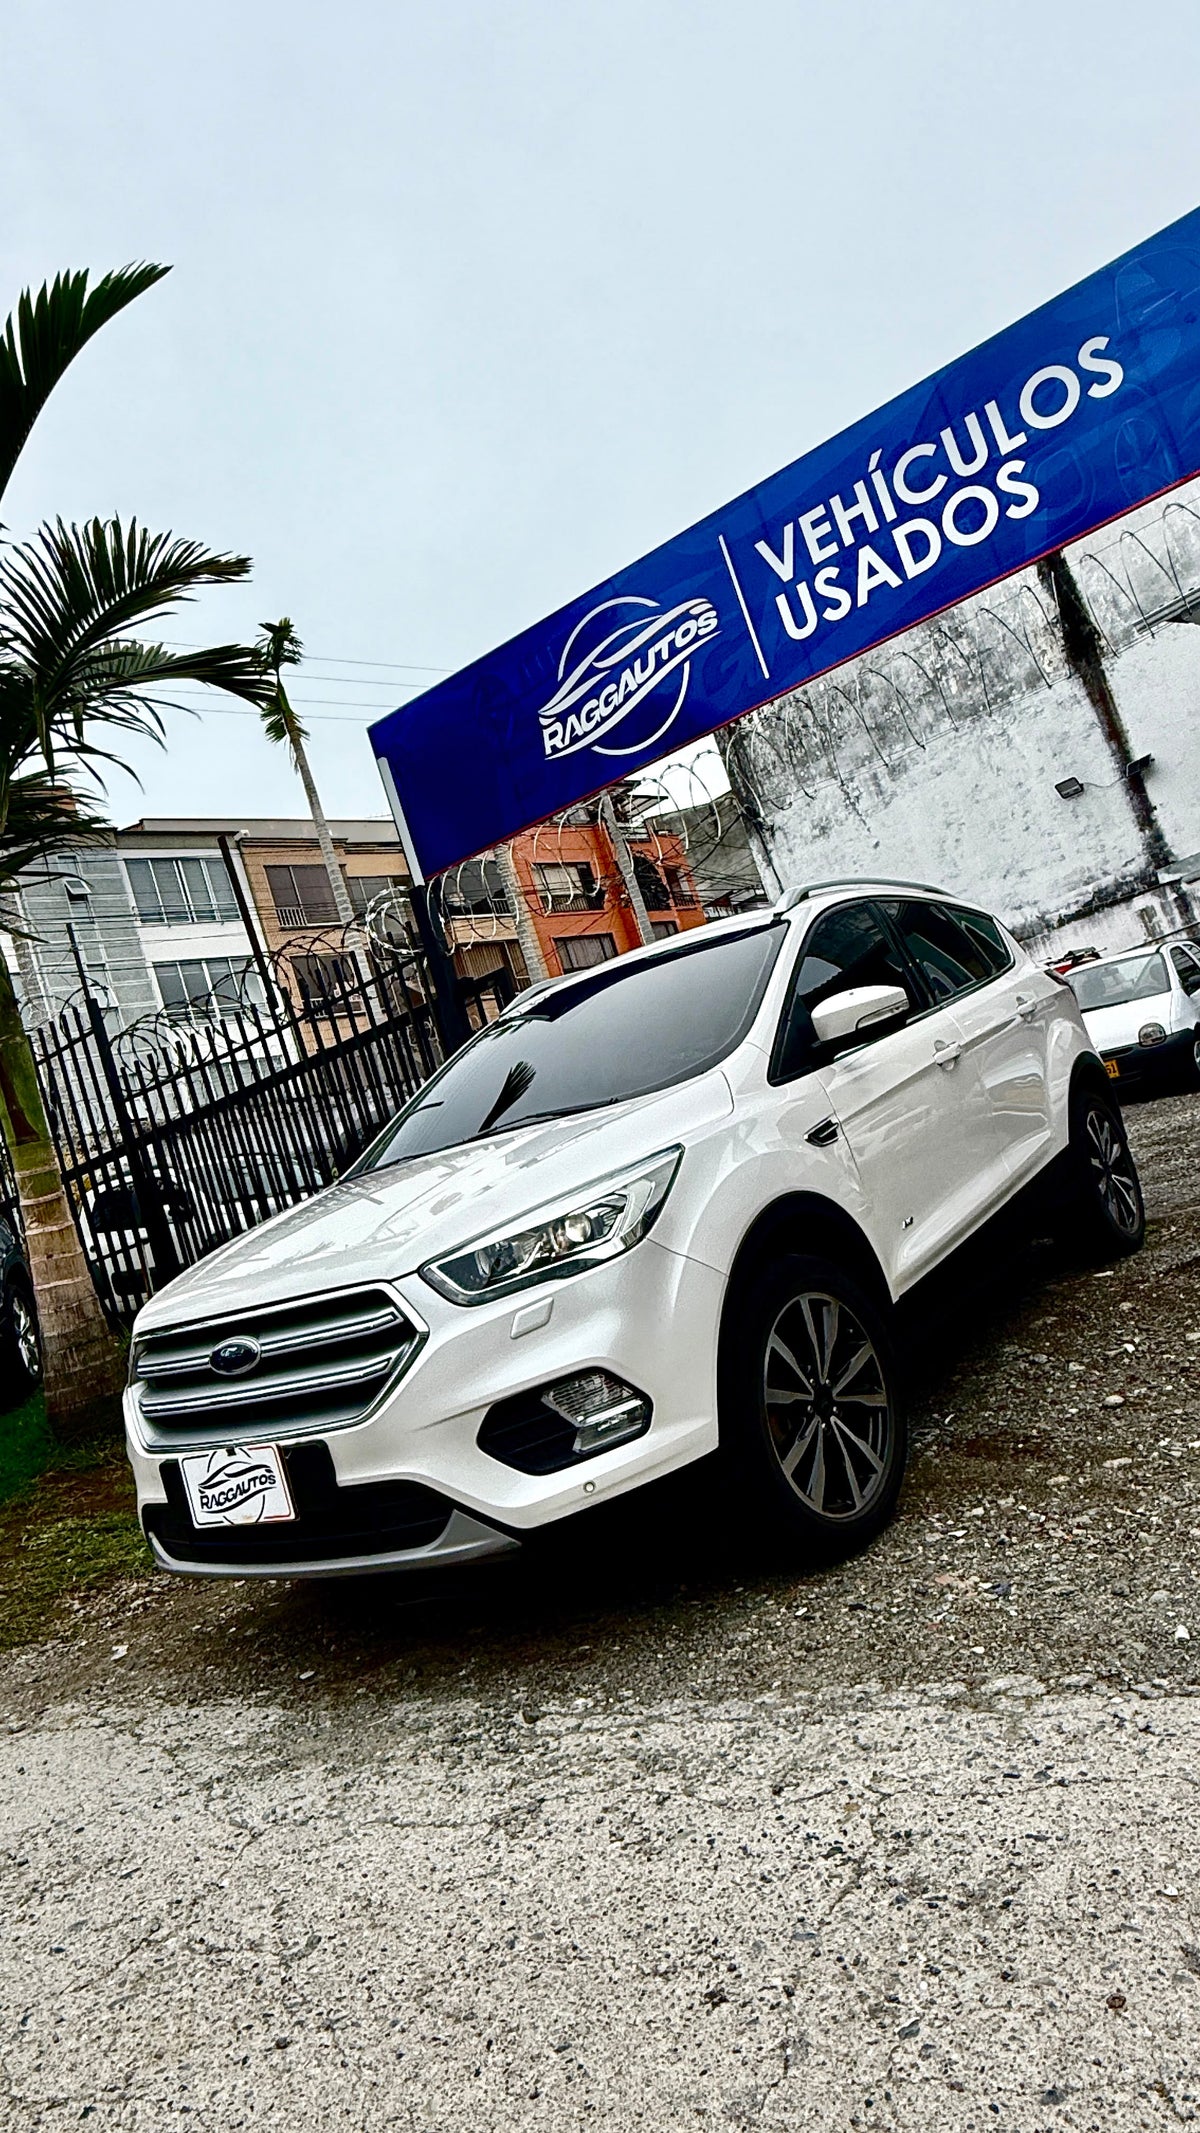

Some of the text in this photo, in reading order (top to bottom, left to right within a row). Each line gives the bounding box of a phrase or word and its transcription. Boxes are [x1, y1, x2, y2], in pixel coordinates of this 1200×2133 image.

[754, 336, 1124, 583] VEHÍCULOS
[775, 459, 1040, 640] USADOS
[542, 610, 718, 755] RAGGAUTOS
[200, 1474, 277, 1510] RAGGAUTOS
